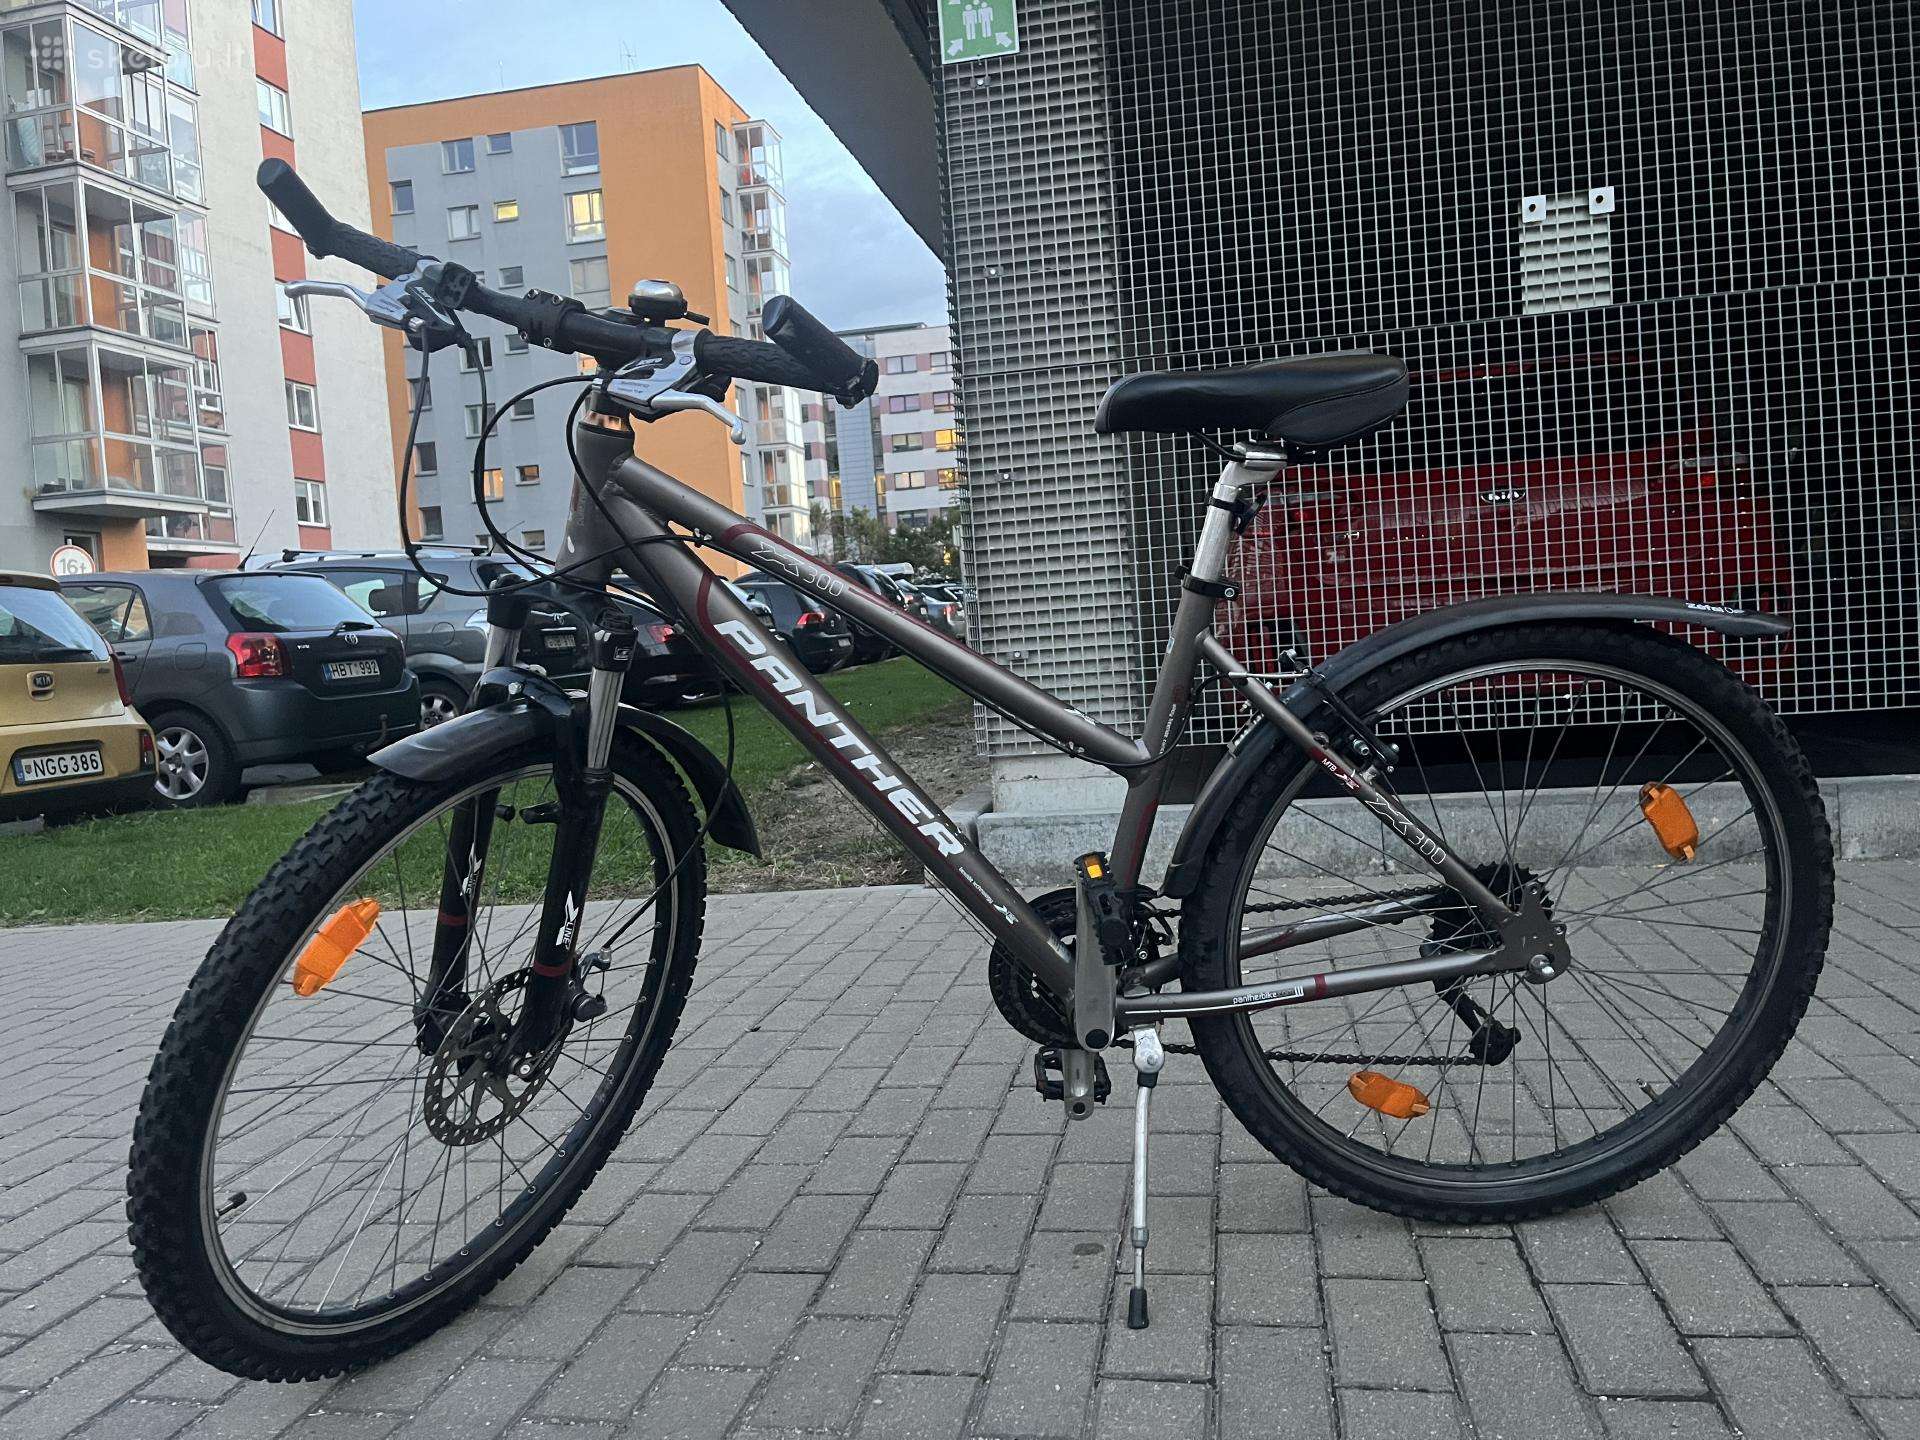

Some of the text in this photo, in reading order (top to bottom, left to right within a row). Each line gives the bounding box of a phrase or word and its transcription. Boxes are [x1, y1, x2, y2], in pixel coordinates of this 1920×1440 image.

[331, 661, 379, 677] HBT 992
[35, 675, 51, 686] KIA
[714, 619, 964, 857] PANTHER
[33, 754, 99, 777] NGG 386
[1322, 758, 1337, 772] MTB
